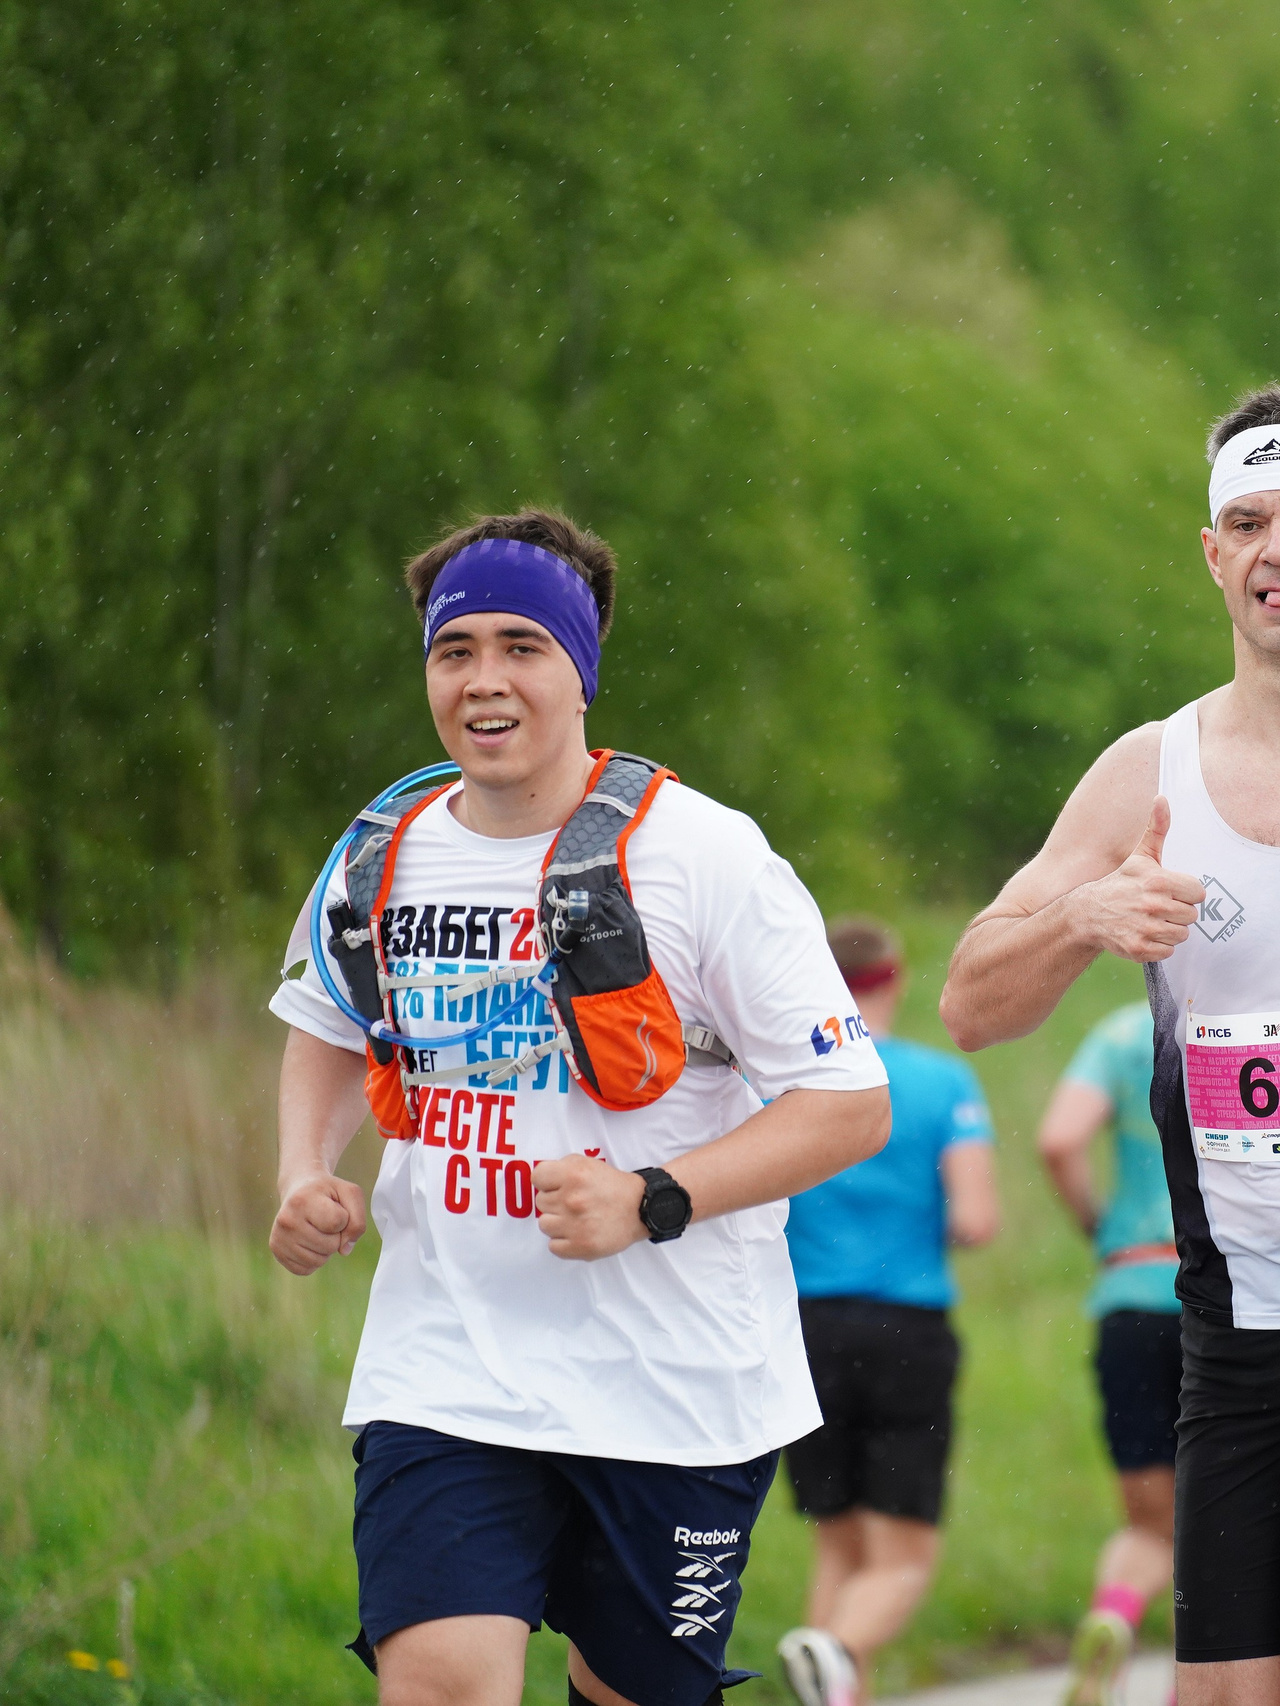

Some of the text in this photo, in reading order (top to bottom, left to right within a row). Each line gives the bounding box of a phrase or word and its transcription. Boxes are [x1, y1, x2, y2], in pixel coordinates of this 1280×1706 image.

[1218, 915, 1246, 942] TEAM
[845, 1014, 869, 1041] ПС
[1208, 1028, 1232, 1038] ПСБ
[1205, 1133, 1229, 1141] СИБУР
[674, 1526, 741, 1547] Reebok
